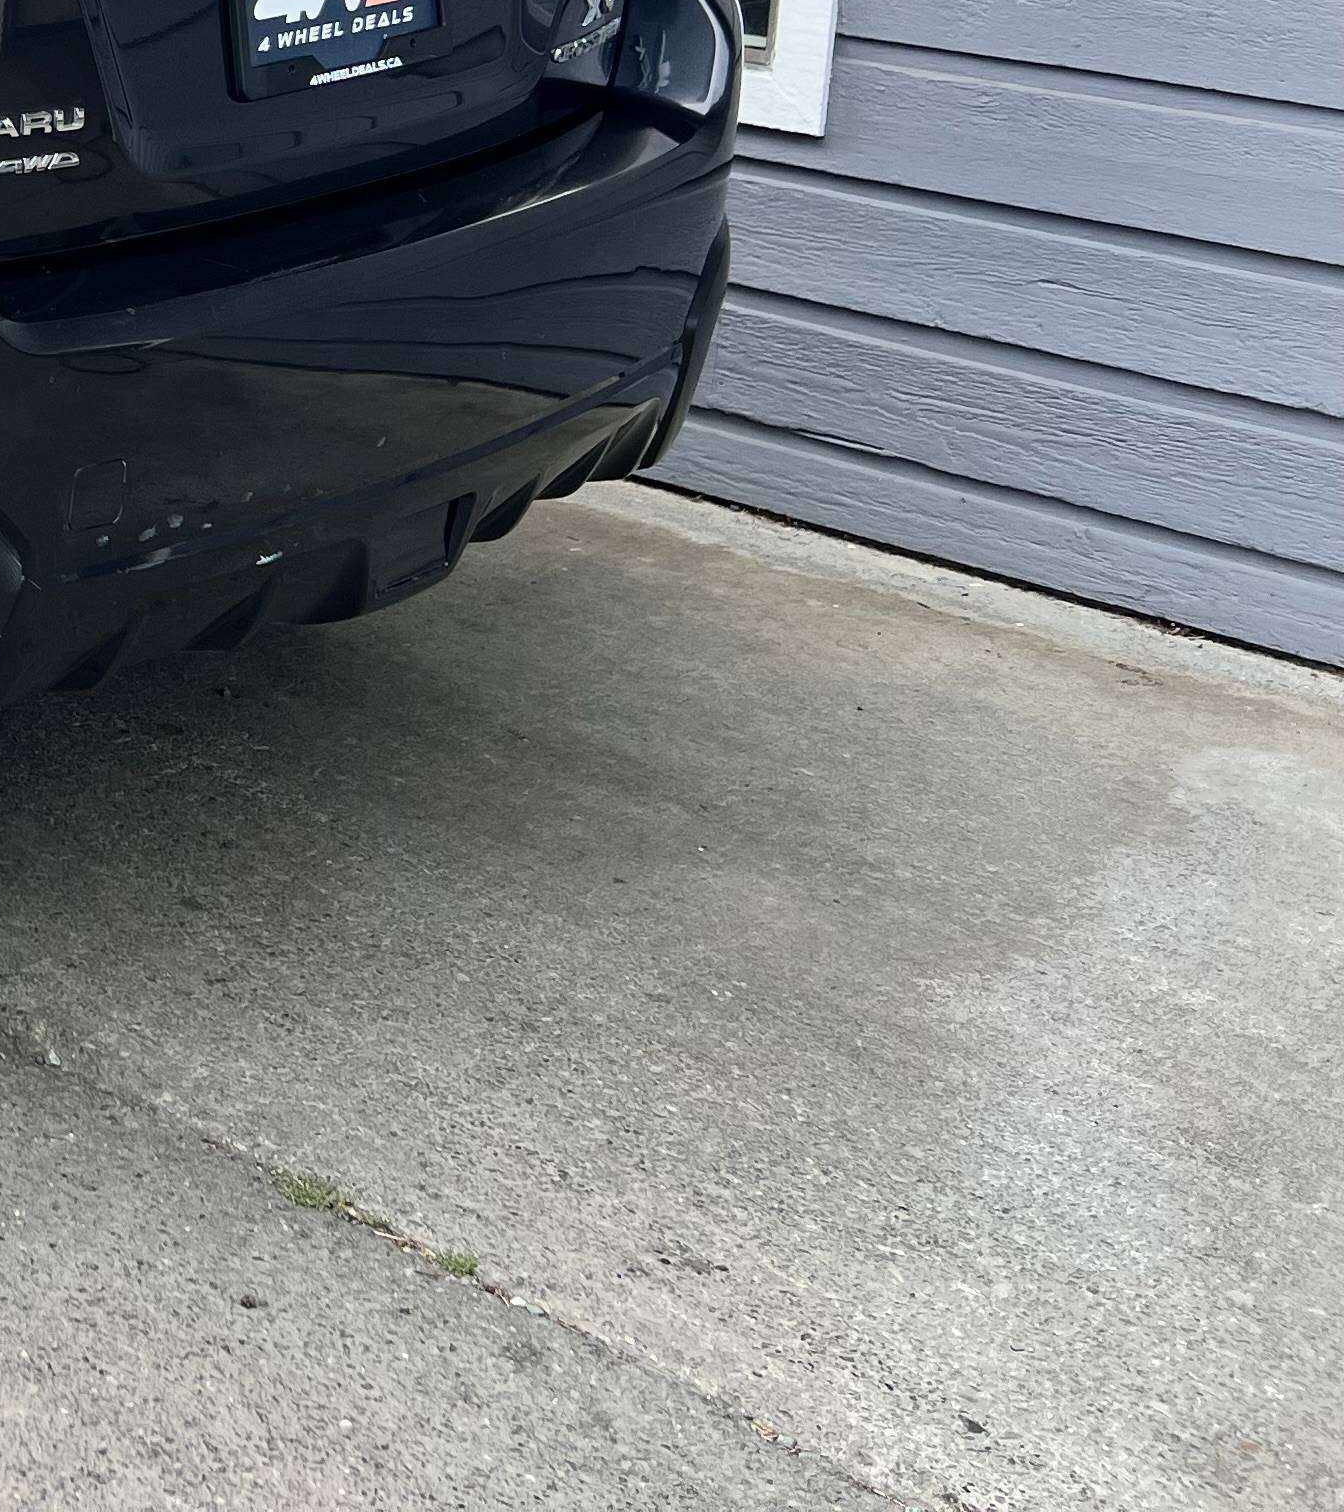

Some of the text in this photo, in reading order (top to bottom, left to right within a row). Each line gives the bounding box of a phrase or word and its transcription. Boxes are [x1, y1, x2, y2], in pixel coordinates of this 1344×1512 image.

[257, 5, 415, 53] 4 WHEEL DEALS
[309, 55, 404, 86] 4WHEELDEALS.CA
